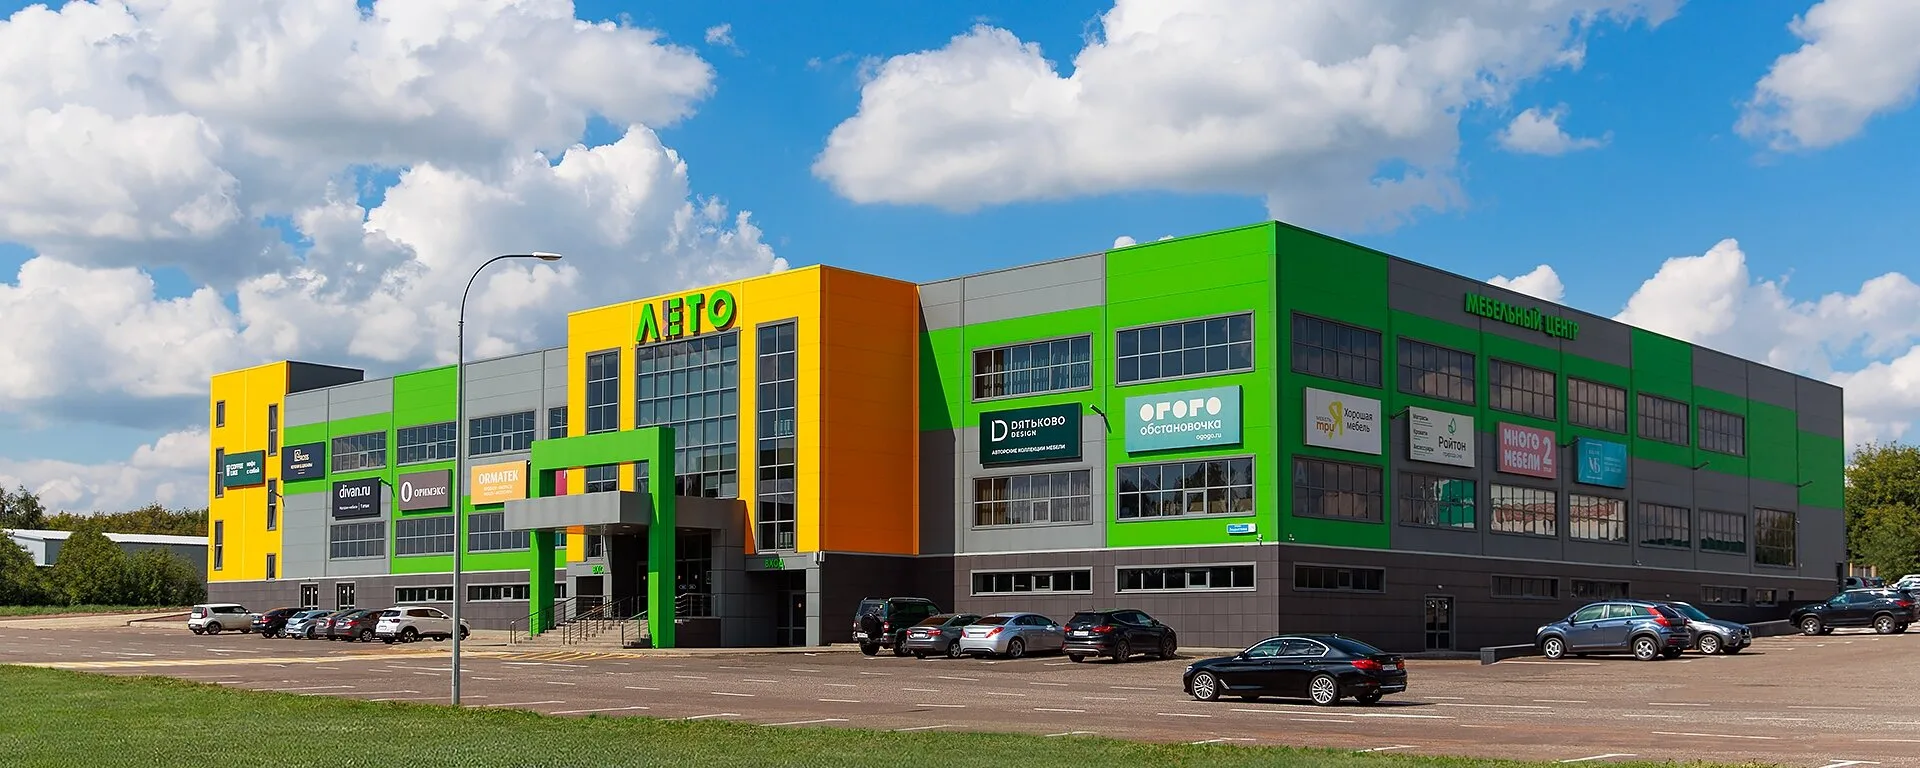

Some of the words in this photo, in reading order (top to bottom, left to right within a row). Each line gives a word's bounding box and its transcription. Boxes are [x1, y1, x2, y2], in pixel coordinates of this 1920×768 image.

[636, 289, 735, 343] ЛЕТО
[1465, 291, 1541, 331] МЕБЕЛЬНЫЙ
[1544, 314, 1579, 341] ЦЕНТР
[1140, 397, 1221, 421] ОГОГО
[1344, 408, 1373, 421] Хорошая
[1011, 430, 1036, 438] DESIGN
[1140, 420, 1221, 436] обстановочка
[1347, 421, 1370, 433] мебель
[1504, 429, 1539, 450] МНОГО
[1543, 437, 1552, 465] 2
[1504, 450, 1540, 471] МЕБЕЛИ
[479, 470, 518, 484] ORMATEK
[339, 484, 371, 498] divan.ru
[414, 487, 446, 497] ОРИМЭКС
[765, 558, 785, 570] ВХОД
